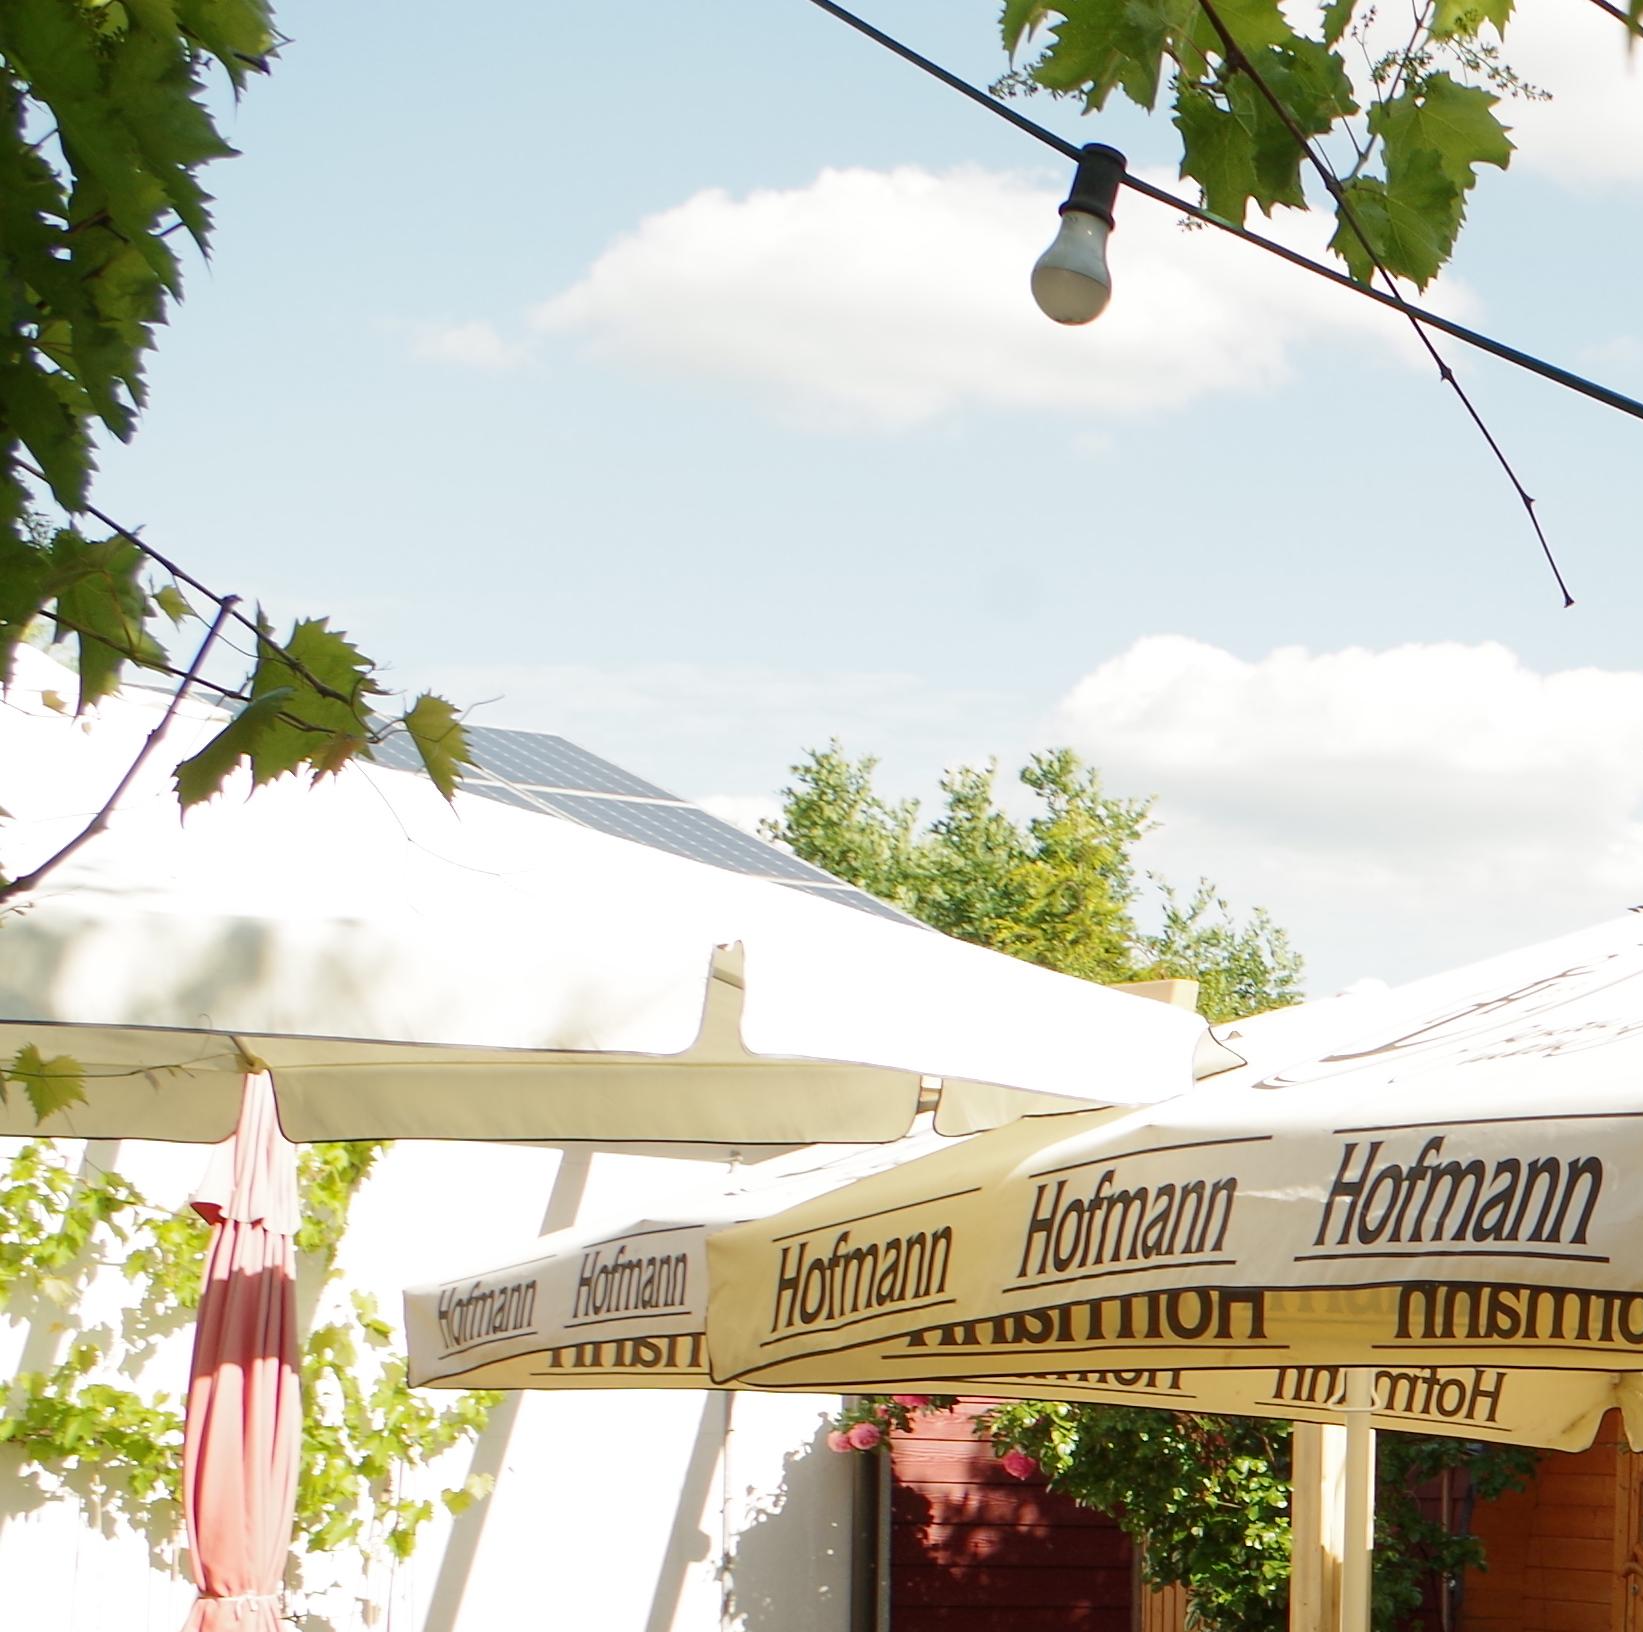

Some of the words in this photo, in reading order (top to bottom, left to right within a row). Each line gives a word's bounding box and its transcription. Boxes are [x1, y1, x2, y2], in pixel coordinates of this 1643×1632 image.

[1015, 1168, 1239, 1279] Hofmann
[1313, 1136, 1602, 1246] Hofmann
[438, 1279, 537, 1349] Hofmann
[572, 1245, 687, 1319] Hofmann
[769, 1223, 954, 1334] Hofmann
